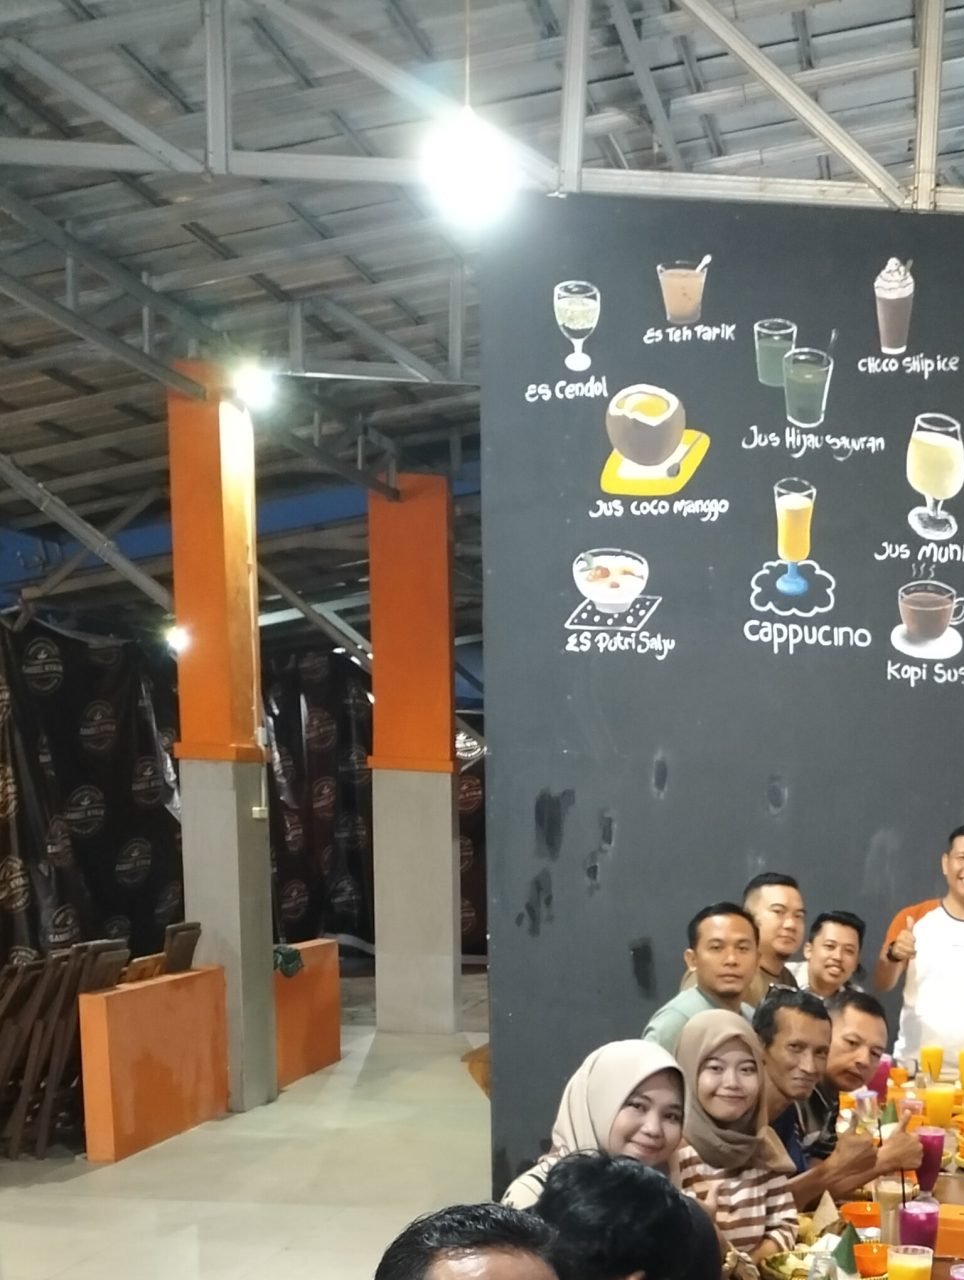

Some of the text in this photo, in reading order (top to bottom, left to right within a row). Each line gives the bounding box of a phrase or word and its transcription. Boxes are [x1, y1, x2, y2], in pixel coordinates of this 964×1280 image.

[555, 375, 608, 400] Cendol
[741, 425, 780, 449] Jus
[886, 660, 927, 687] Kopi
